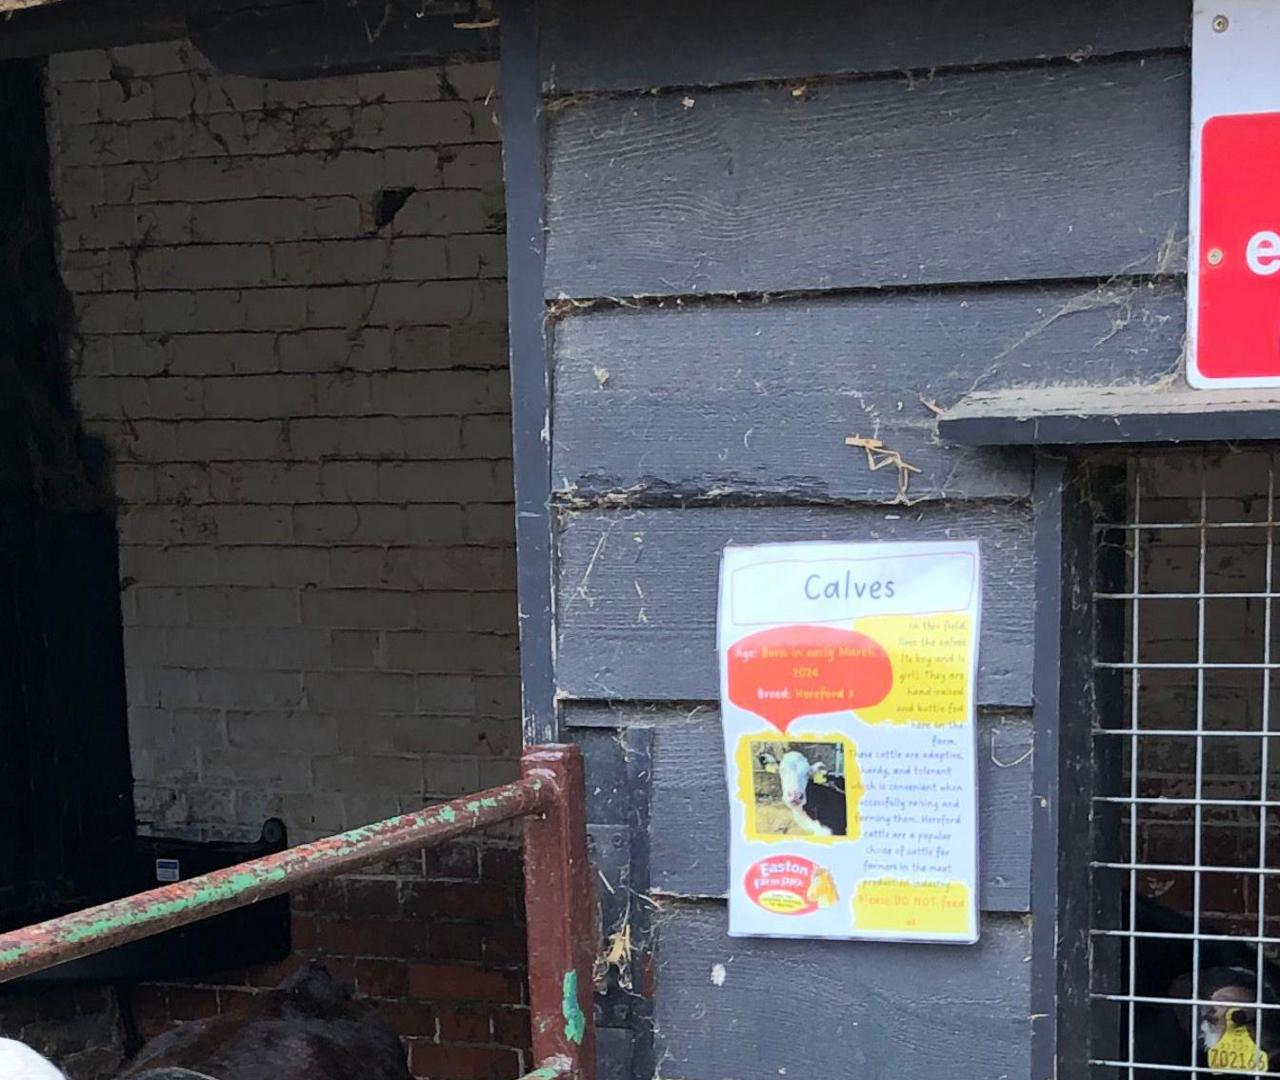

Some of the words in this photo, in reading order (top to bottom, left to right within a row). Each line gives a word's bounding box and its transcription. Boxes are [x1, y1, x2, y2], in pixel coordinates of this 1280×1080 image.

[803, 569, 897, 602] Calves
[923, 621, 940, 631] this
[921, 638, 935, 647] the
[939, 638, 967, 647] calves
[735, 646, 757, 663] Age:
[761, 646, 786, 659] Born
[791, 647, 802, 658] in
[806, 646, 834, 663] early
[915, 653, 932, 667] boy
[935, 654, 954, 663] and
[791, 666, 819, 679] 2024
[925, 670, 946, 683] They
[949, 673, 964, 681] are
[756, 686, 793, 700] Breed:
[795, 687, 846, 702] Hereford
[896, 704, 914, 713] and
[917, 703, 945, 713] bottle
[948, 702, 963, 714] fed
[949, 719, 964, 729] the
[875, 749, 902, 759] cattle
[893, 767, 911, 775] and
[914, 767, 952, 776] tolerant
[888, 783, 937, 792] convenient
[940, 782, 963, 791] when
[908, 799, 938, 812] raising
[942, 798, 960, 808] and
[921, 814, 961, 826] Hereford
[863, 829, 889, 839] cattle
[918, 831, 952, 843] popular
[865, 844, 892, 855] choice
[907, 847, 933, 856] cattle
[936, 846, 950, 858] for
[760, 860, 809, 877] Easton
[863, 860, 898, 872] farmers
[912, 862, 926, 872] the
[929, 864, 952, 873] meat
[857, 894, 888, 906] Please
[894, 895, 909, 906] DO
[914, 896, 936, 907] NOT
[941, 895, 965, 910] feed
